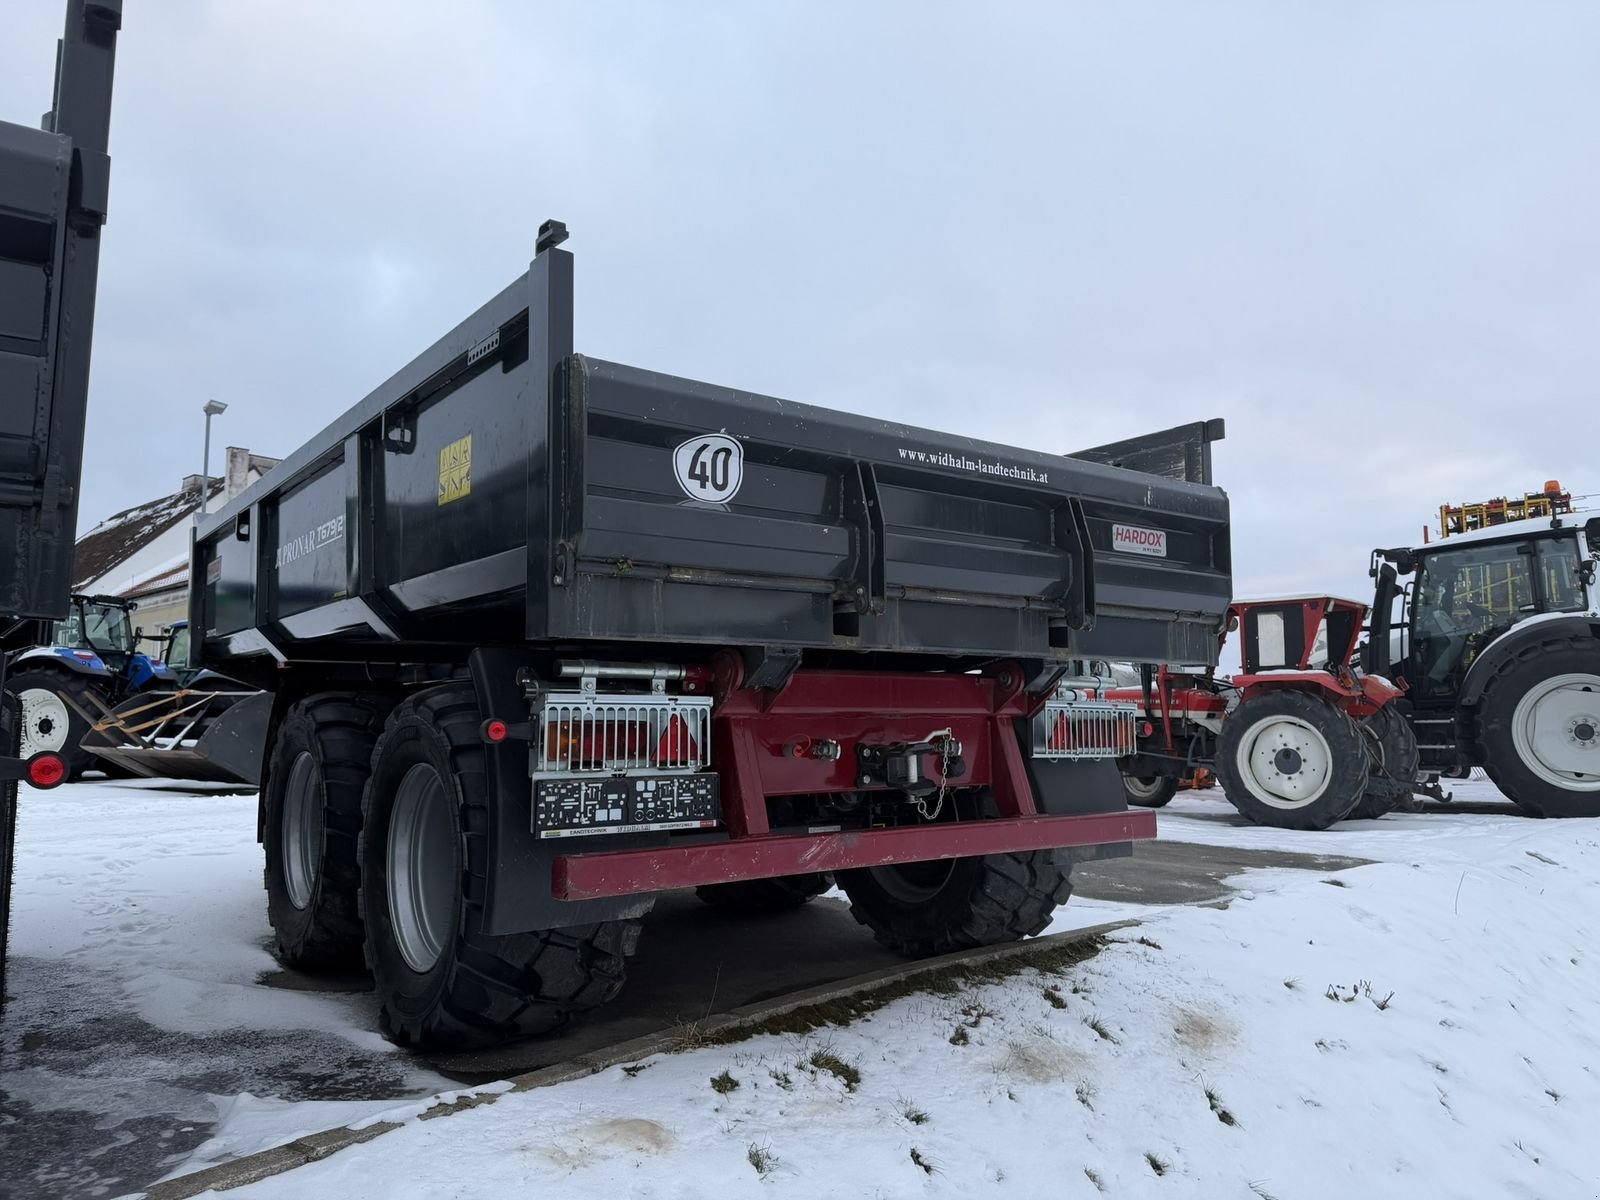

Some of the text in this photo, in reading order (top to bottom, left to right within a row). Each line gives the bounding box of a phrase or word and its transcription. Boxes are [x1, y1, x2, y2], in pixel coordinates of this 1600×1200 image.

[687, 443, 732, 492] 40
[899, 448, 1049, 484] www.widhalm-landtechnik.at
[282, 530, 315, 566] PRONAR
[1115, 527, 1162, 548] HARDOX
